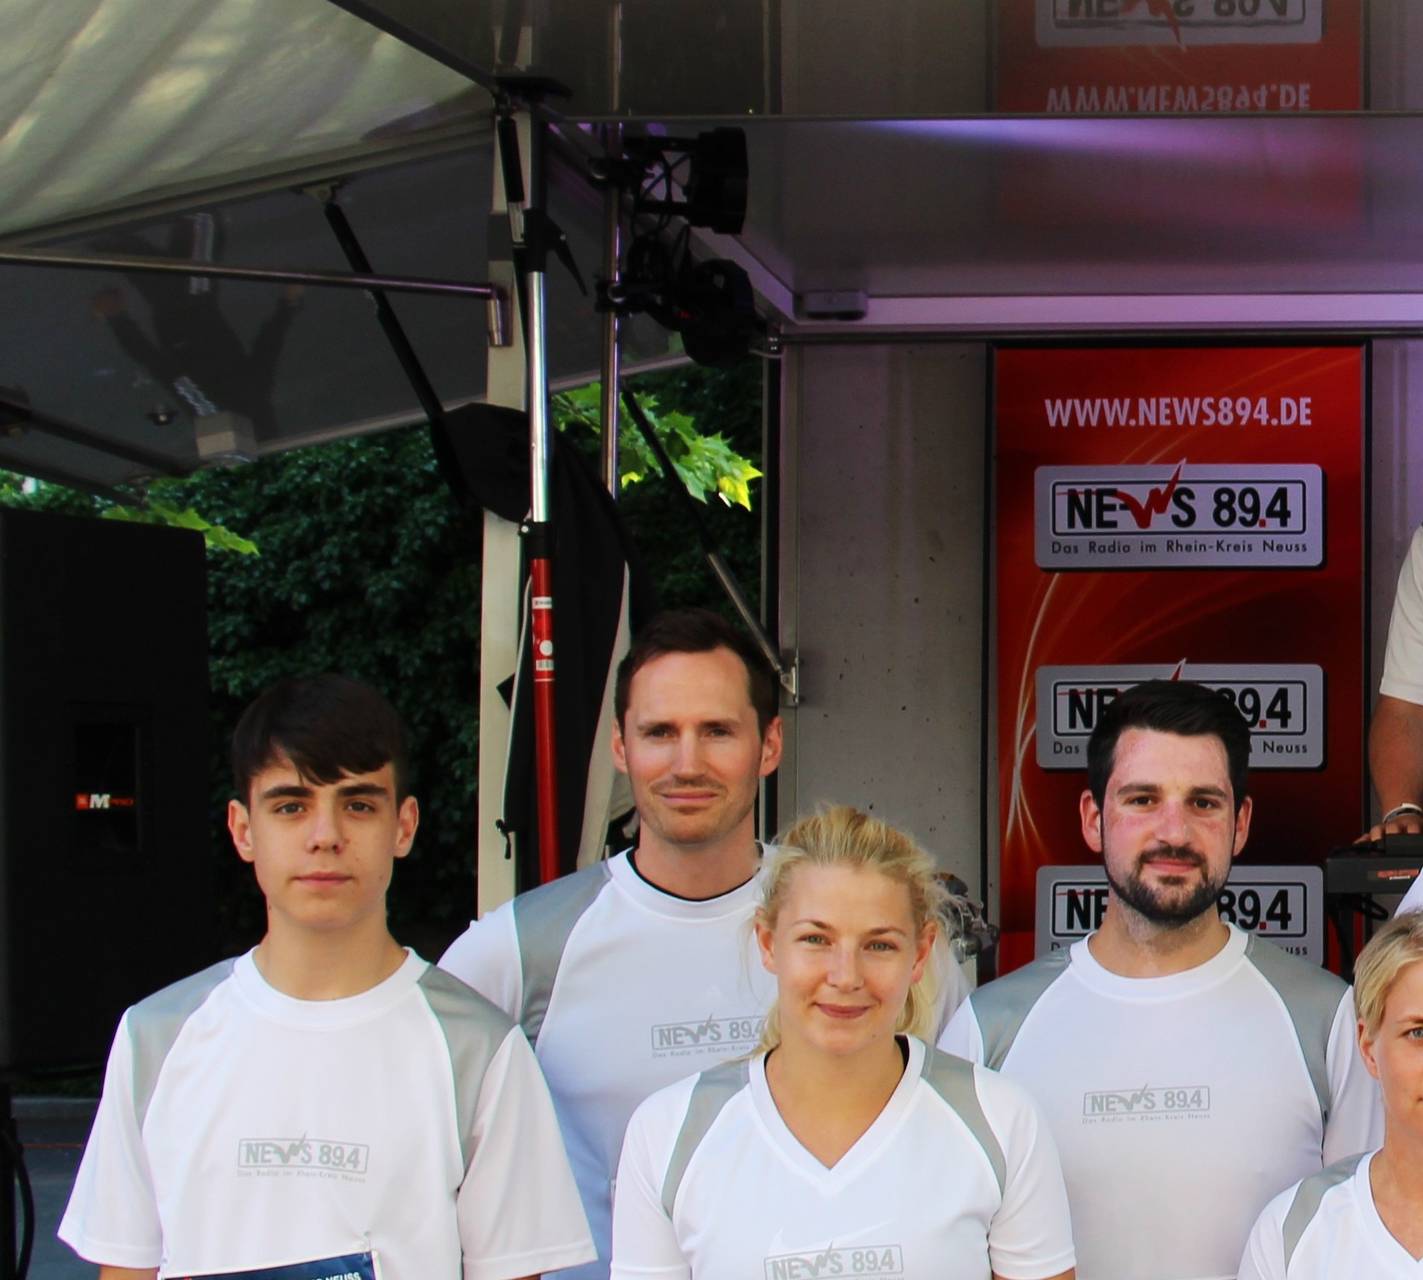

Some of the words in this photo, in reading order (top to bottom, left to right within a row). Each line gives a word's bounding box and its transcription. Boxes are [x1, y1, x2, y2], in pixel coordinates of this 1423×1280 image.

[1044, 396, 1312, 428] WWW.NEWS894.DE
[1064, 459, 1196, 529] NEWS
[1212, 486, 1291, 528] 89.4
[1051, 541, 1078, 554] Das
[1088, 540, 1131, 554] Radio
[1140, 540, 1157, 553] im
[1166, 539, 1254, 553] Rhein-Kreis
[1262, 539, 1308, 553] Neuss
[1221, 687, 1292, 729] 9.4
[1053, 742, 1080, 754] Das
[1262, 740, 1308, 754] Neuss
[1218, 889, 1292, 931] 89.4
[658, 1015, 721, 1046] NEWS
[1090, 1084, 1156, 1113] NEWS
[1163, 1090, 1203, 1109] 89.4
[244, 1132, 312, 1164] NEWS
[318, 1145, 361, 1169] 89.4
[852, 1249, 895, 1273] 89.4
